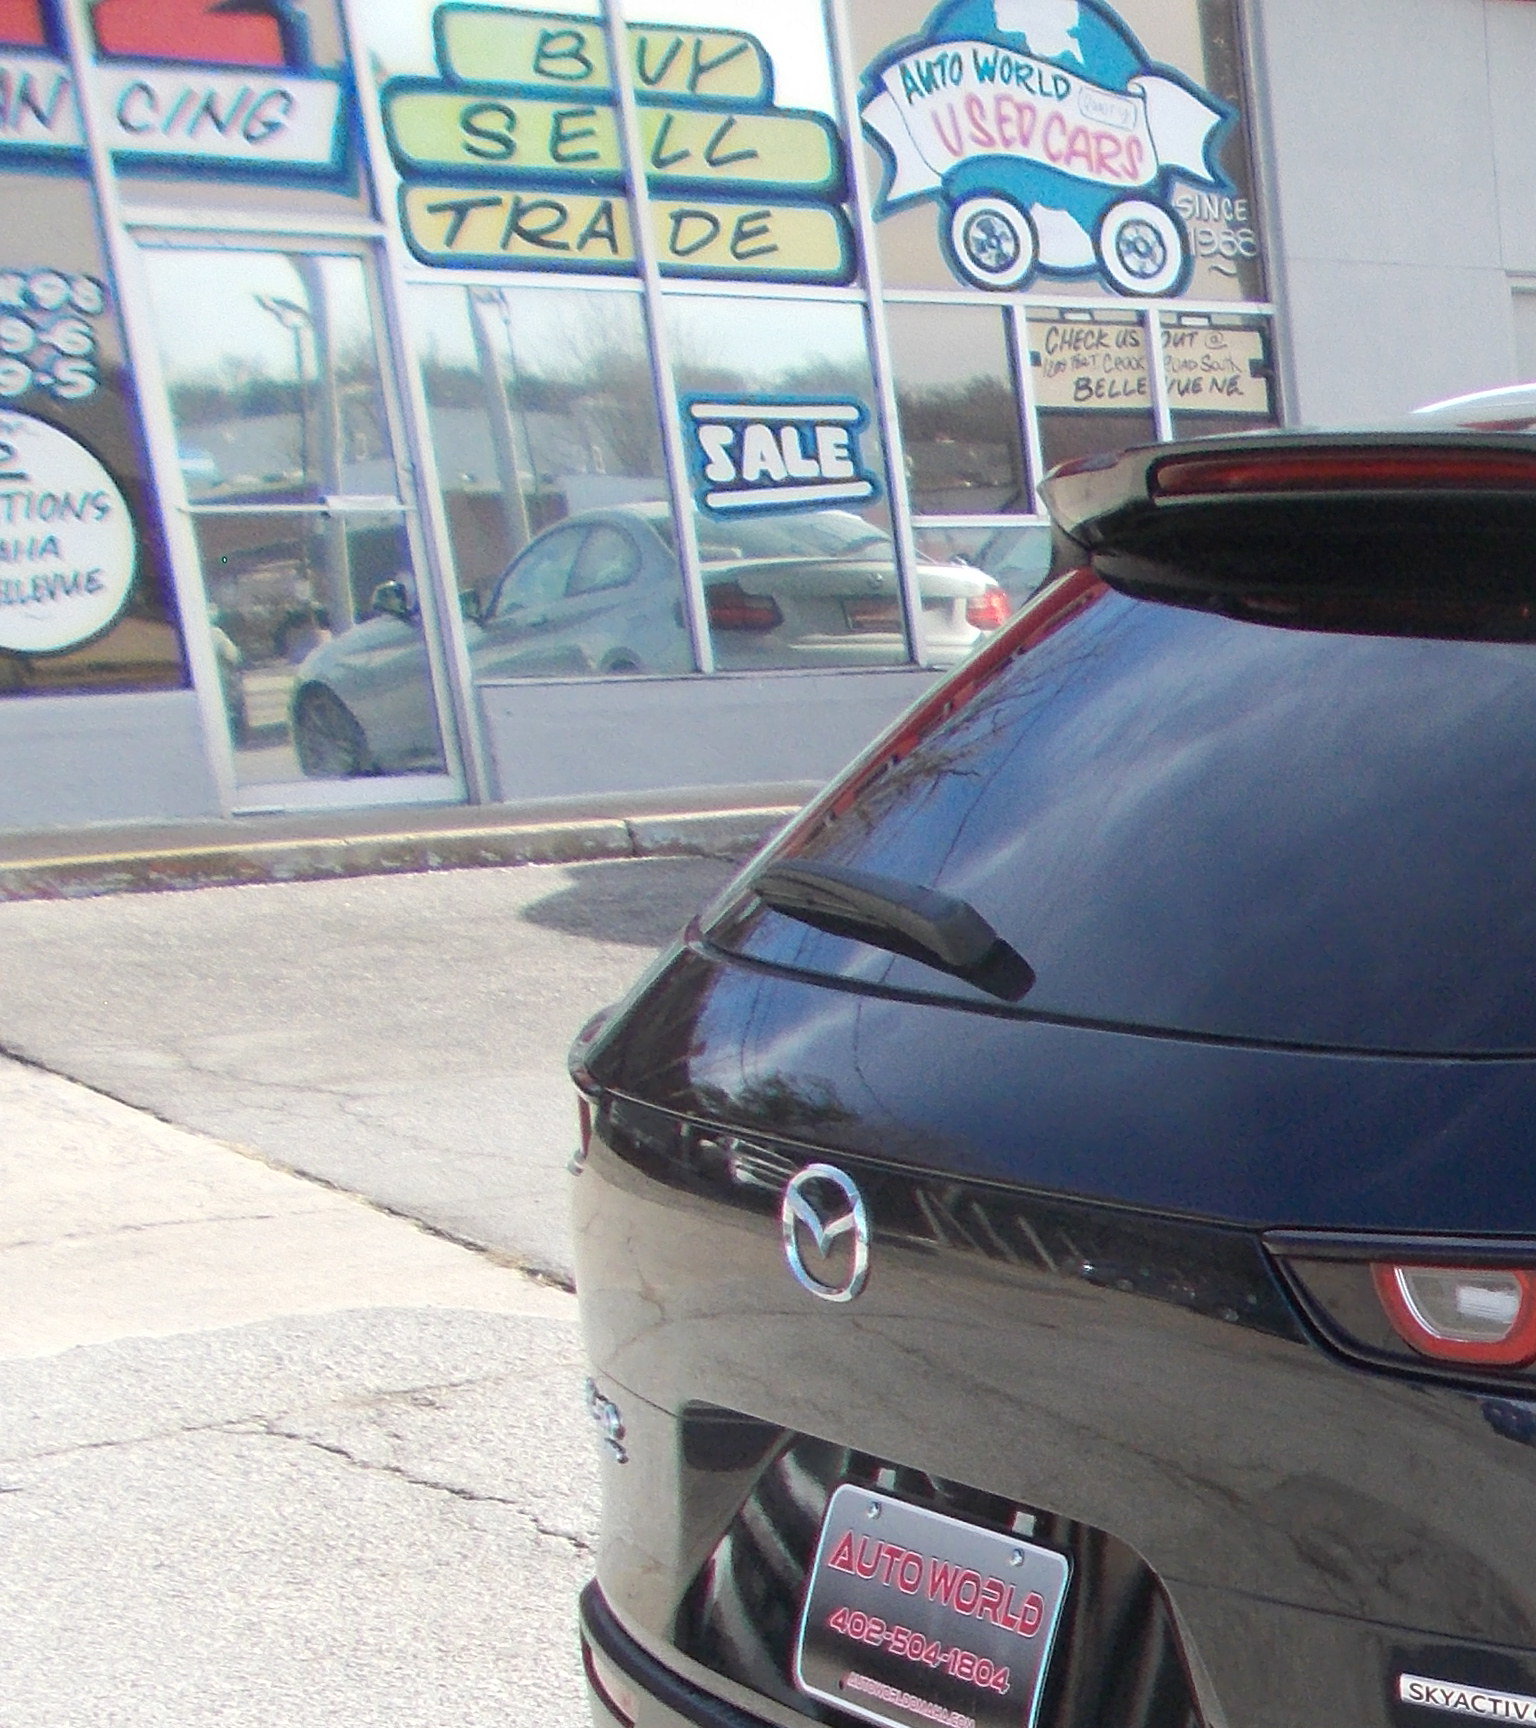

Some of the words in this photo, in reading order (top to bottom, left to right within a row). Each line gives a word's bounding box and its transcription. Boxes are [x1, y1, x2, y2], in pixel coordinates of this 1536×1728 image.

[533, 28, 752, 91] BUY
[899, 51, 964, 106] AUTO
[972, 48, 1071, 102] WORLD
[0, 69, 293, 143] NCING
[460, 103, 759, 170] SELL
[930, 92, 1036, 158] USED
[1042, 112, 1143, 181] CARS
[427, 197, 780, 259] TRADE
[1176, 194, 1248, 224] SINCE
[1045, 328, 1110, 355] CHECK
[1115, 330, 1141, 347] US
[700, 424, 854, 482] SALE
[828, 1530, 923, 1595] AUTO
[928, 1555, 1045, 1638] WORLD
[829, 1607, 1010, 1695] 402-504-1804
[1408, 1682, 1531, 1721] SKYACTIV
